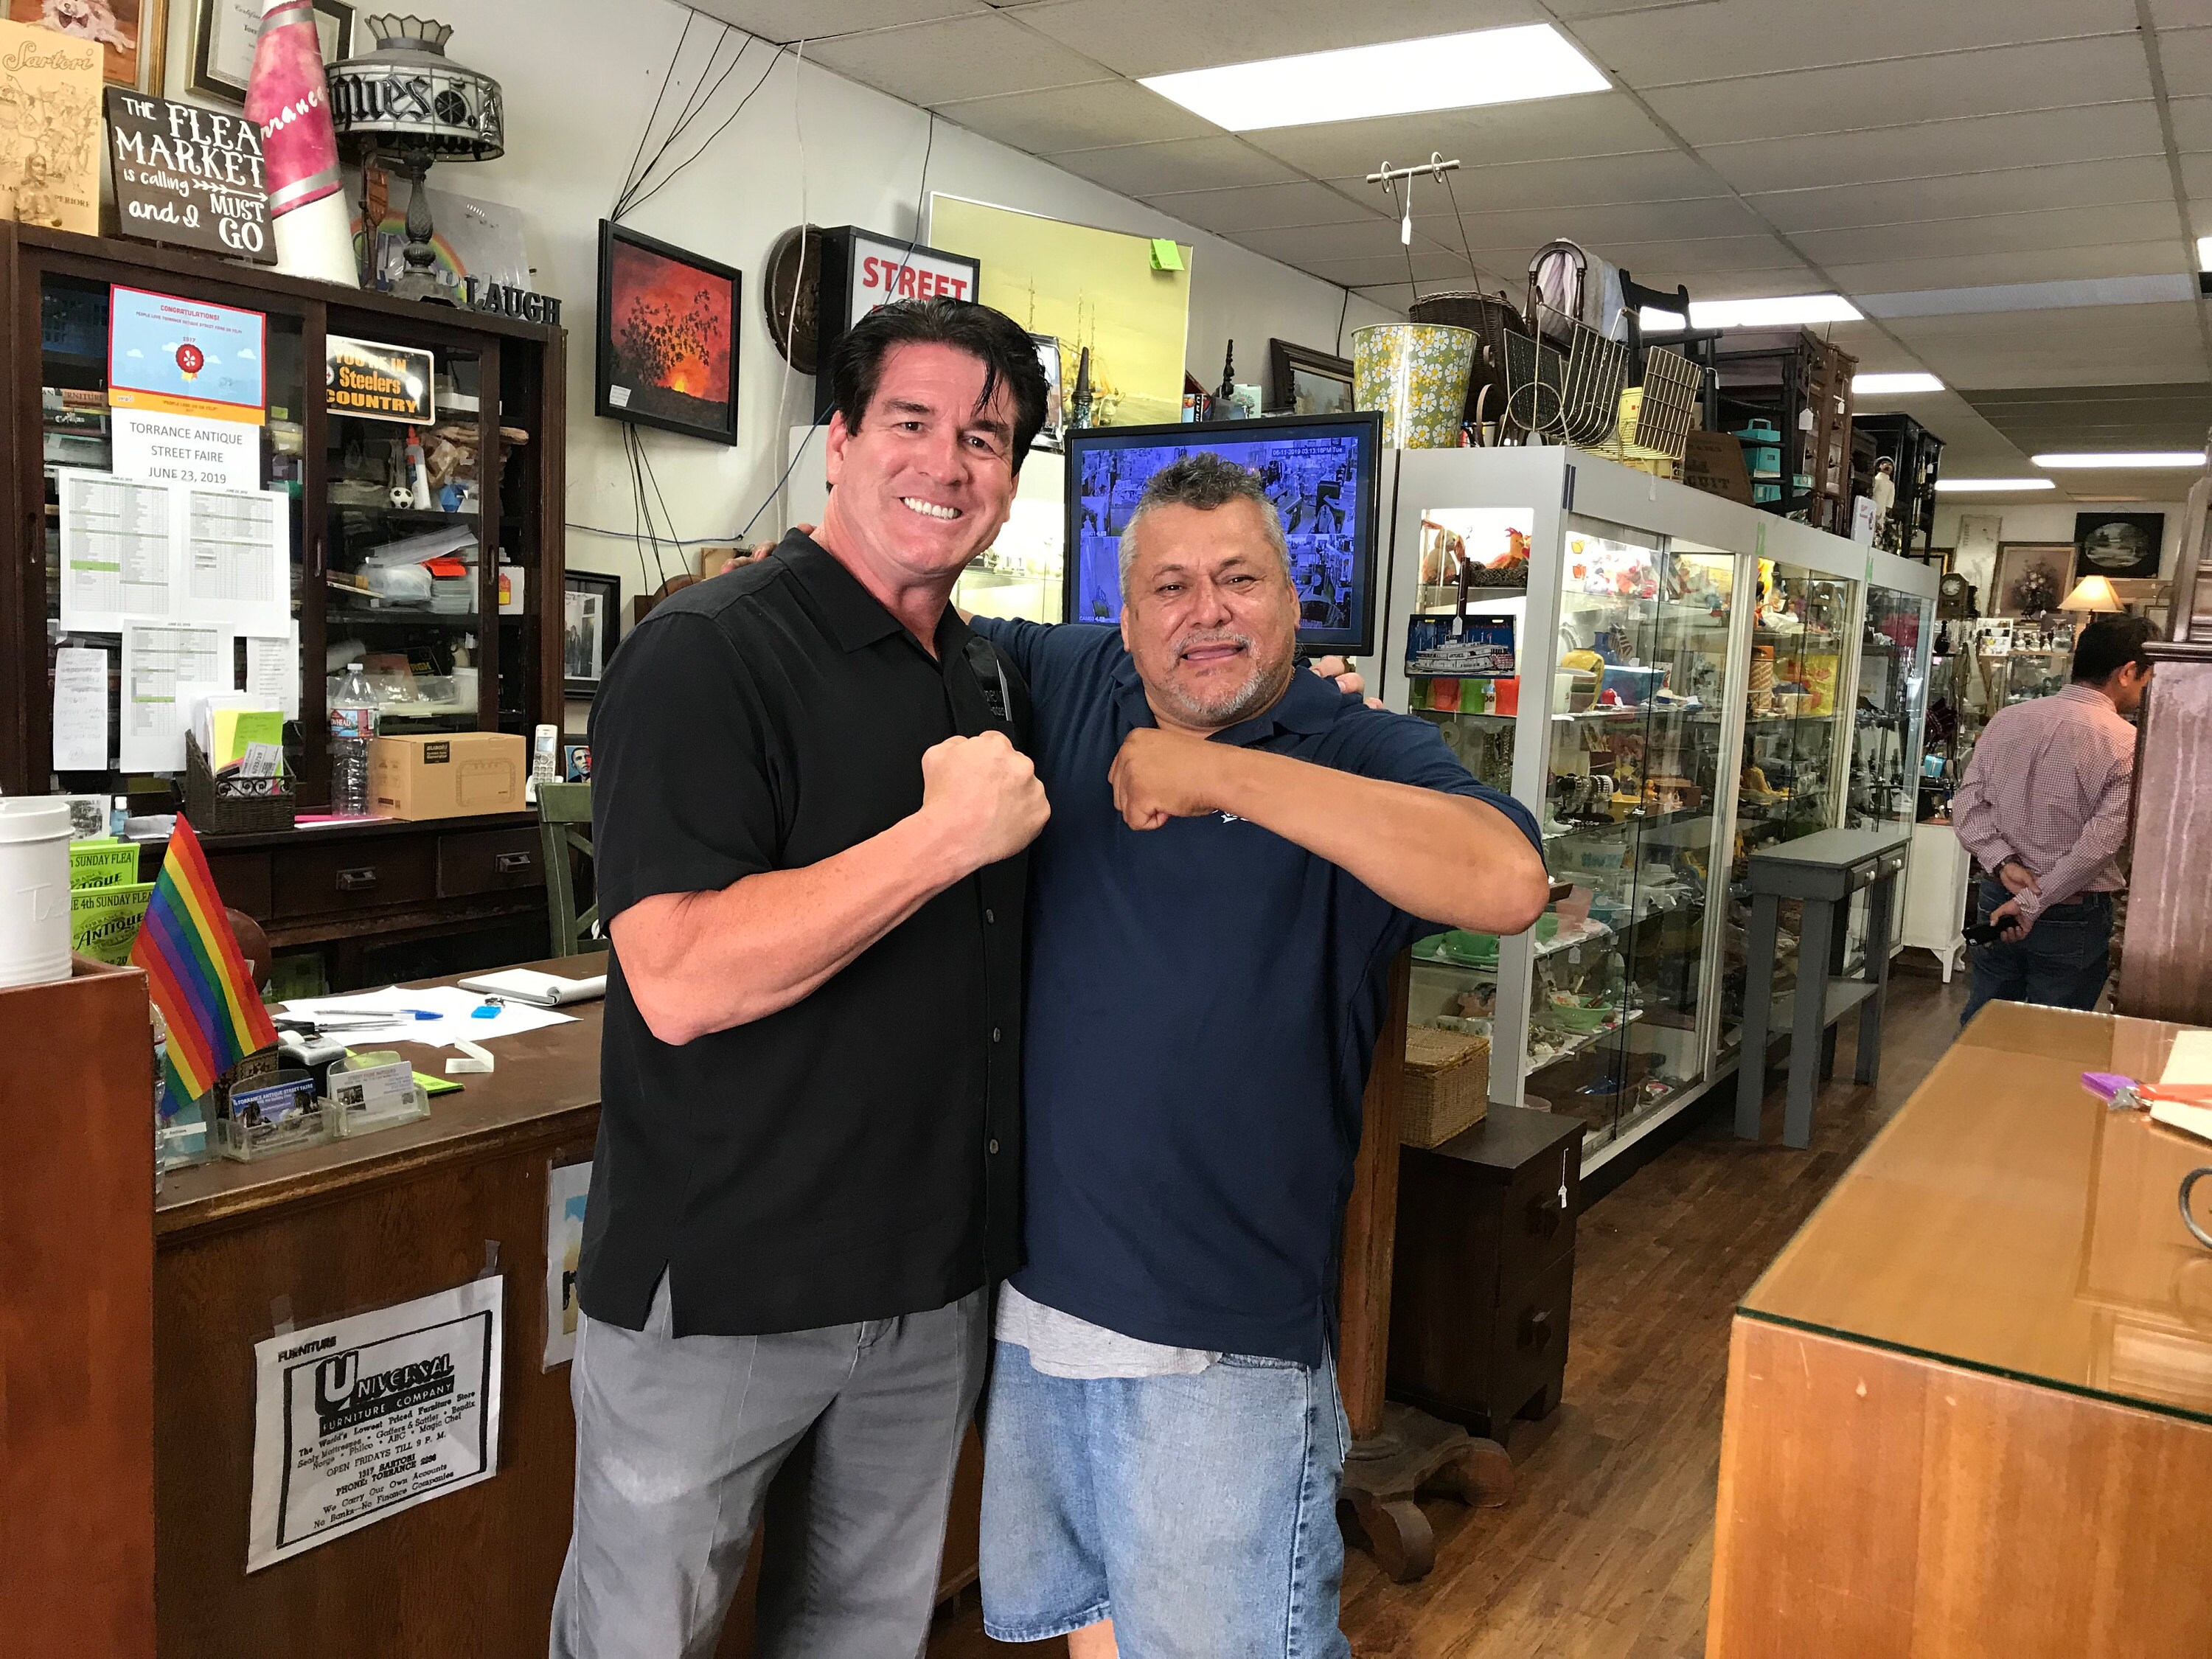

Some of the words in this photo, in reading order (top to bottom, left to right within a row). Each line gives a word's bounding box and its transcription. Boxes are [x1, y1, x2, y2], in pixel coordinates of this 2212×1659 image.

[2, 41, 94, 71] Sartori
[121, 97, 156, 121] THE
[165, 102, 262, 156] FLEA
[115, 126, 265, 189] MARKET
[123, 168, 135, 182] is
[140, 170, 189, 198] calling
[128, 201, 180, 224] and
[209, 193, 265, 223] MUST
[218, 217, 264, 252] GO
[863, 257, 967, 301] STREET
[160, 305, 220, 321] CONGRATULATIONS!
[464, 276, 562, 326] LAUGH
[339, 366, 401, 394] Steelers
[391, 358, 407, 373] IN
[326, 389, 417, 413] COUNTRY
[130, 422, 191, 439] TORRANCE
[194, 430, 243, 445] ANTIQUE
[151, 445, 192, 459] STREET
[195, 450, 223, 463] FAIRE
[148, 467, 177, 479] JUNE
[181, 470, 197, 483] 23,
[201, 472, 226, 484] 2019
[75, 854, 110, 868] SUNDAY
[111, 852, 131, 864] FLEA
[80, 897, 94, 910] 4th
[96, 893, 131, 908] SUNDAY
[278, 1336, 337, 1363] FURNITURE
[321, 1351, 454, 1405] UNIVERSAL
[324, 1403, 385, 1430] FURNITURE
[397, 1383, 451, 1408] COMPANY
[297, 1454, 320, 1469] Sealy
[376, 1425, 406, 1439] Gaffers
[408, 1421, 413, 1430] &
[415, 1413, 439, 1427] Sattler
[451, 1400, 476, 1414] Bendix
[299, 1446, 313, 1458] The
[319, 1431, 347, 1449] World's
[354, 1422, 382, 1436] Lowest
[389, 1411, 413, 1425] Priced
[418, 1399, 451, 1415] Furniture
[456, 1391, 476, 1402] Store
[313, 1455, 335, 1470] Norge
[349, 1441, 373, 1456] Philco
[388, 1433, 406, 1444] ABC
[420, 1420, 442, 1434] Magic
[445, 1412, 462, 1425] Chef
[326, 1461, 349, 1478] OPEN
[355, 1449, 391, 1467] FRIDAYS
[395, 1442, 413, 1454] TILL
[417, 1439, 422, 1448] 9
[437, 1431, 447, 1441] M.
[372, 1460, 417, 1482] TORRANCE
[313, 1519, 325, 1529] No
[377, 1488, 408, 1504] Finance
[411, 1470, 454, 1490] Companies
[323, 1504, 337, 1514] We
[341, 1492, 365, 1507] Carry
[369, 1485, 384, 1496] Our
[389, 1476, 408, 1488] Own
[412, 1464, 448, 1481] Accounts
